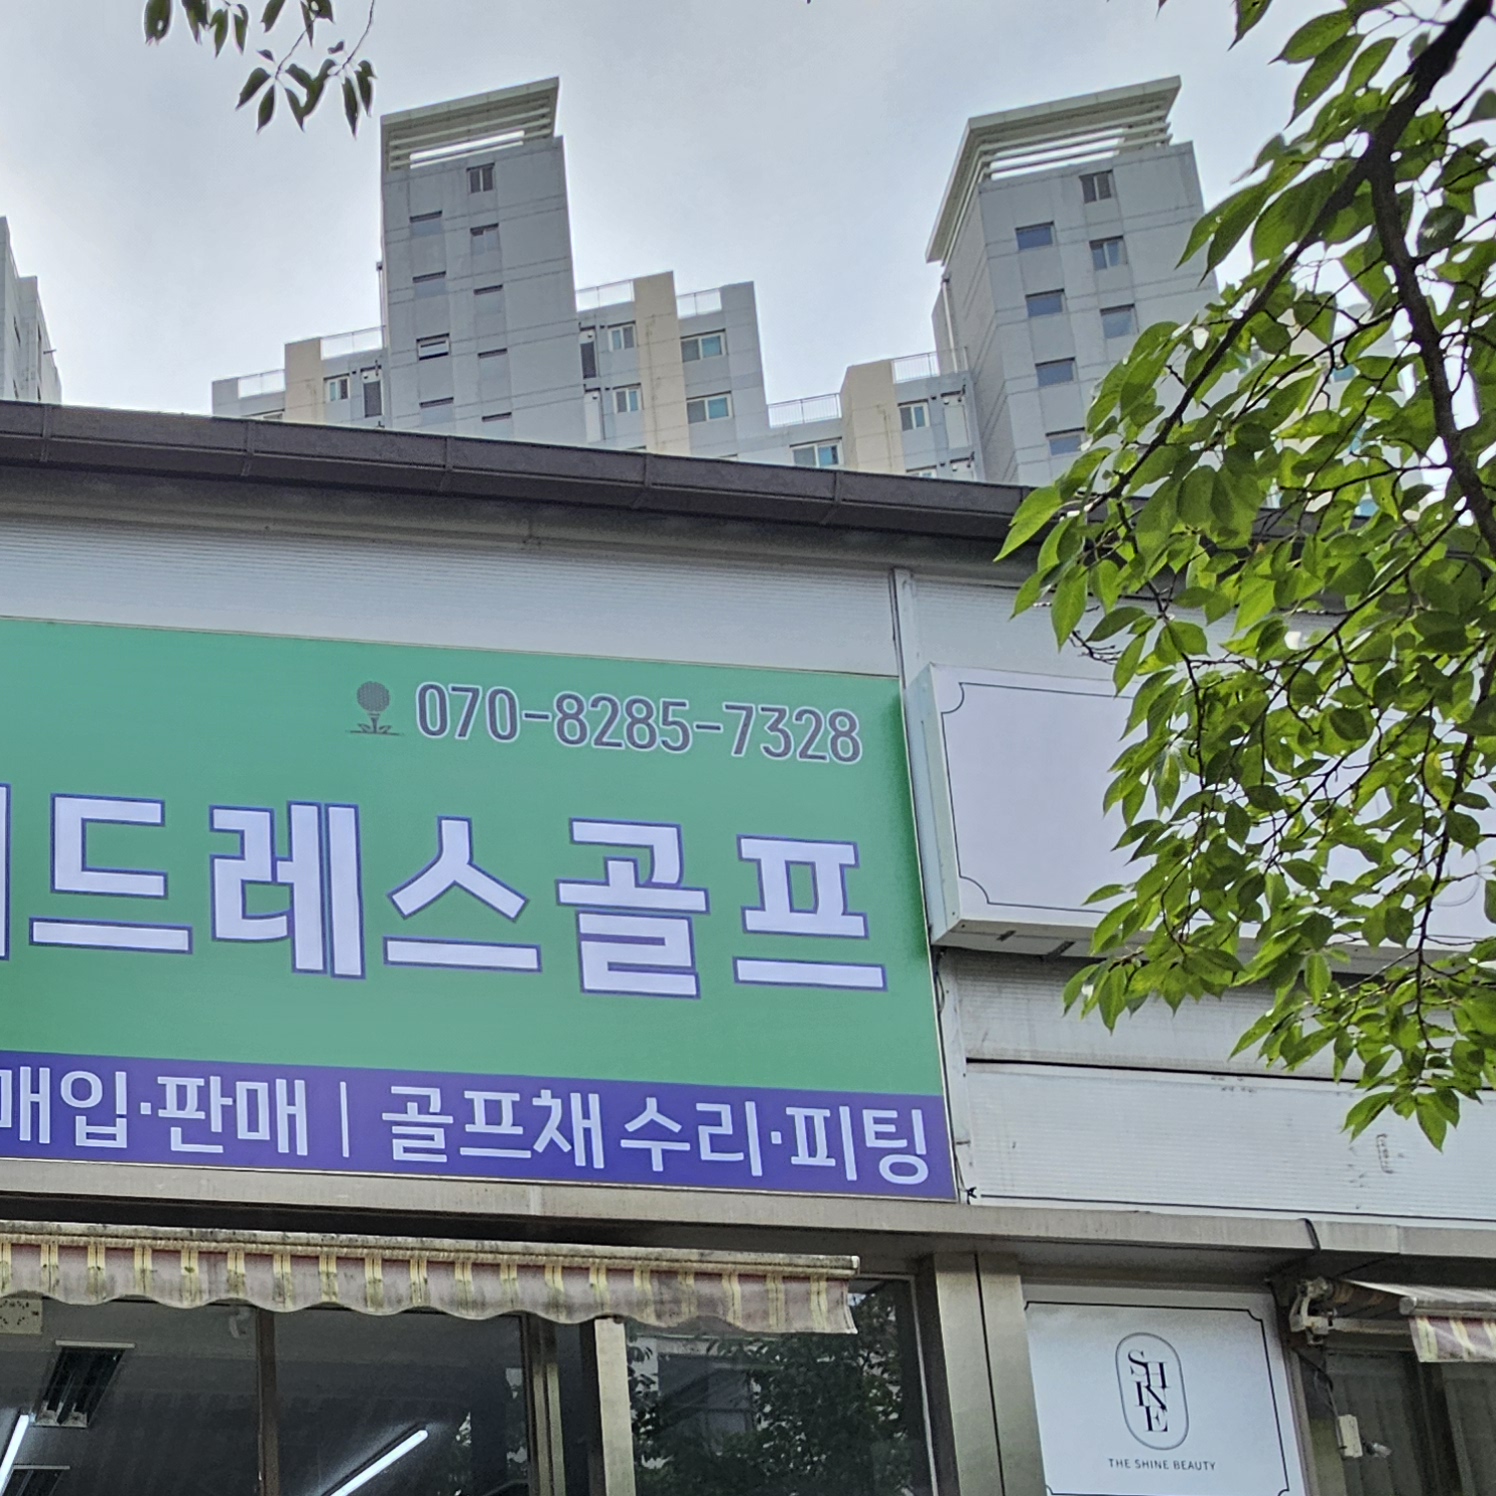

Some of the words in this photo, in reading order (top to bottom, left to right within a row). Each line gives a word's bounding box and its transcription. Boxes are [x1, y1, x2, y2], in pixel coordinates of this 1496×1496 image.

[414, 681, 863, 764] 070-8285-7328
[381, 1084, 605, 1170] 골프채
[620, 1097, 930, 1186] 수리·피팅
[1108, 1458, 1131, 1469] THE
[1134, 1459, 1169, 1470] SHINE
[1173, 1460, 1216, 1471] BEAUTY
